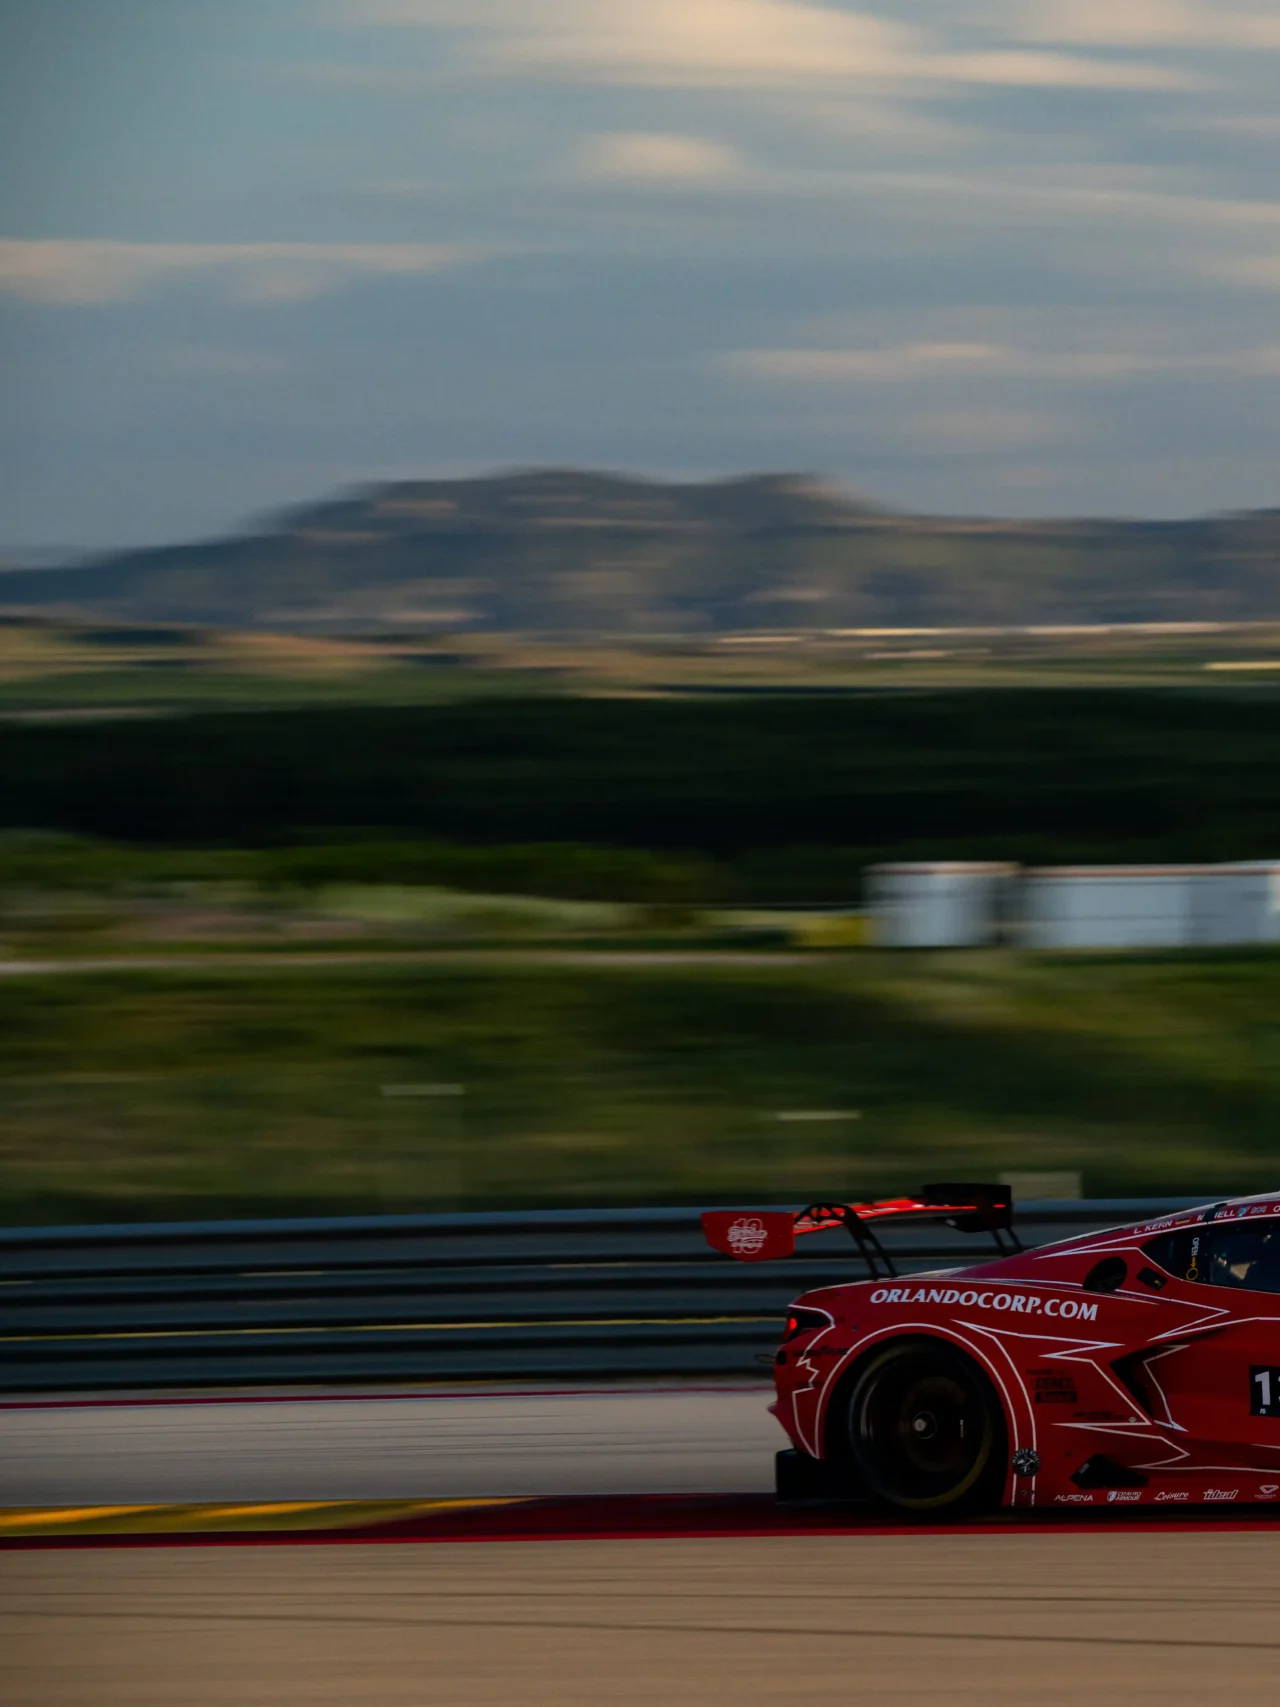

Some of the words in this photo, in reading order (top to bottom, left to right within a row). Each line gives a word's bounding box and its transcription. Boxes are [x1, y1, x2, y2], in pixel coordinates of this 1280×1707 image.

[1144, 1220, 1173, 1232] KERN
[1191, 1237, 1200, 1256] OPEN
[869, 1288, 1099, 1321] ORLANDOCORP.COM
[1053, 1494, 1094, 1502] ALPENA
[1153, 1491, 1190, 1501] Leisure
[1203, 1488, 1239, 1500] ideal
